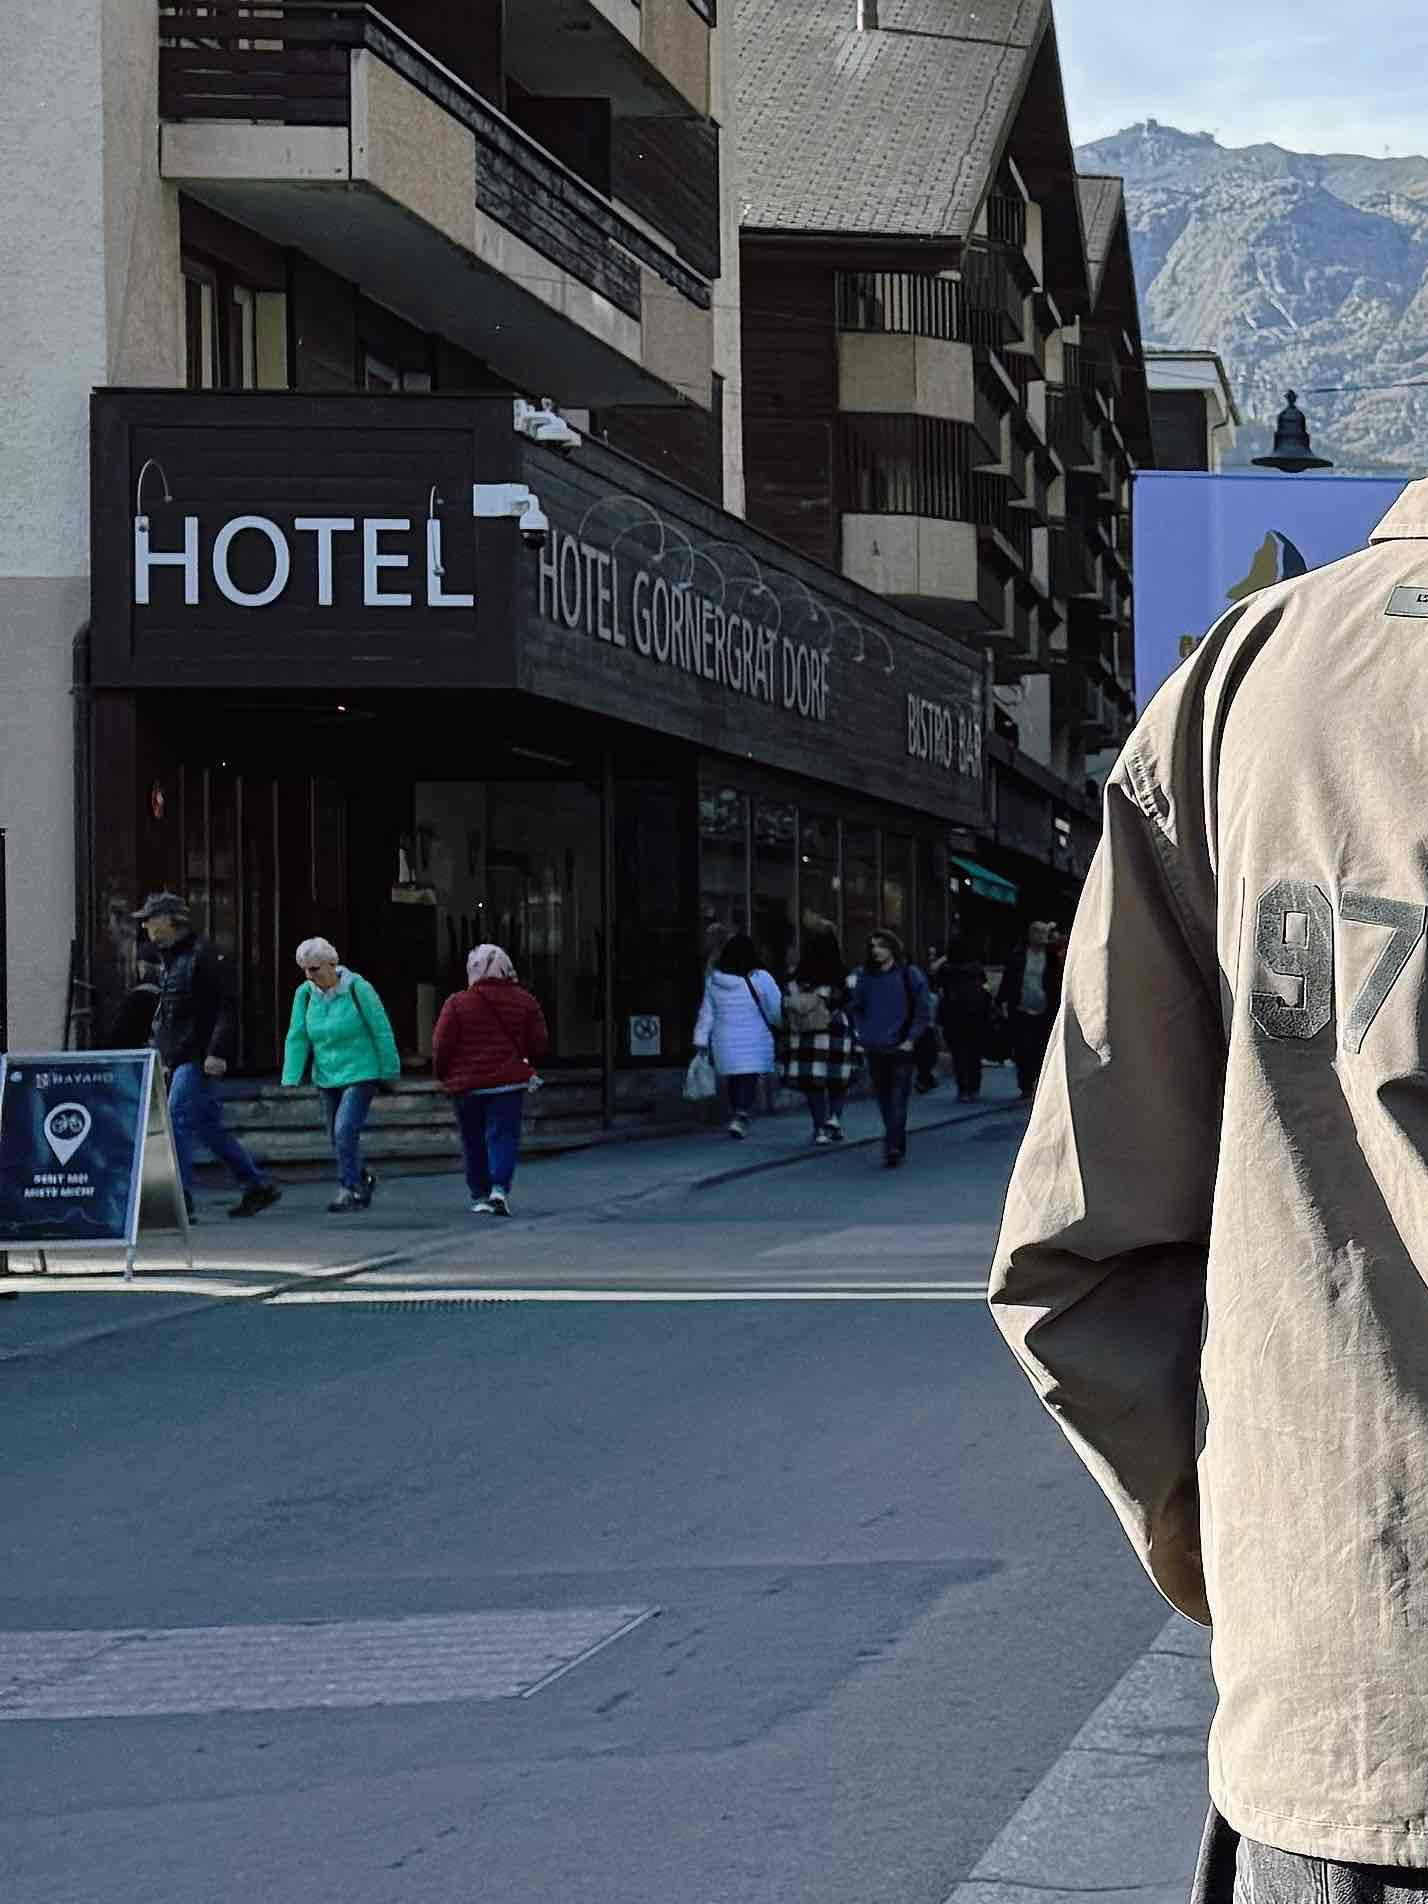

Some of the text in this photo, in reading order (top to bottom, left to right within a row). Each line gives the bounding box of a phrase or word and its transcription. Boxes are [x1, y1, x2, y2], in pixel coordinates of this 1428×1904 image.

[134, 515, 474, 607] HOTEL
[538, 529, 831, 721] HOTEL GORNERGRAT DORF
[906, 693, 984, 779] BISTRO BAR
